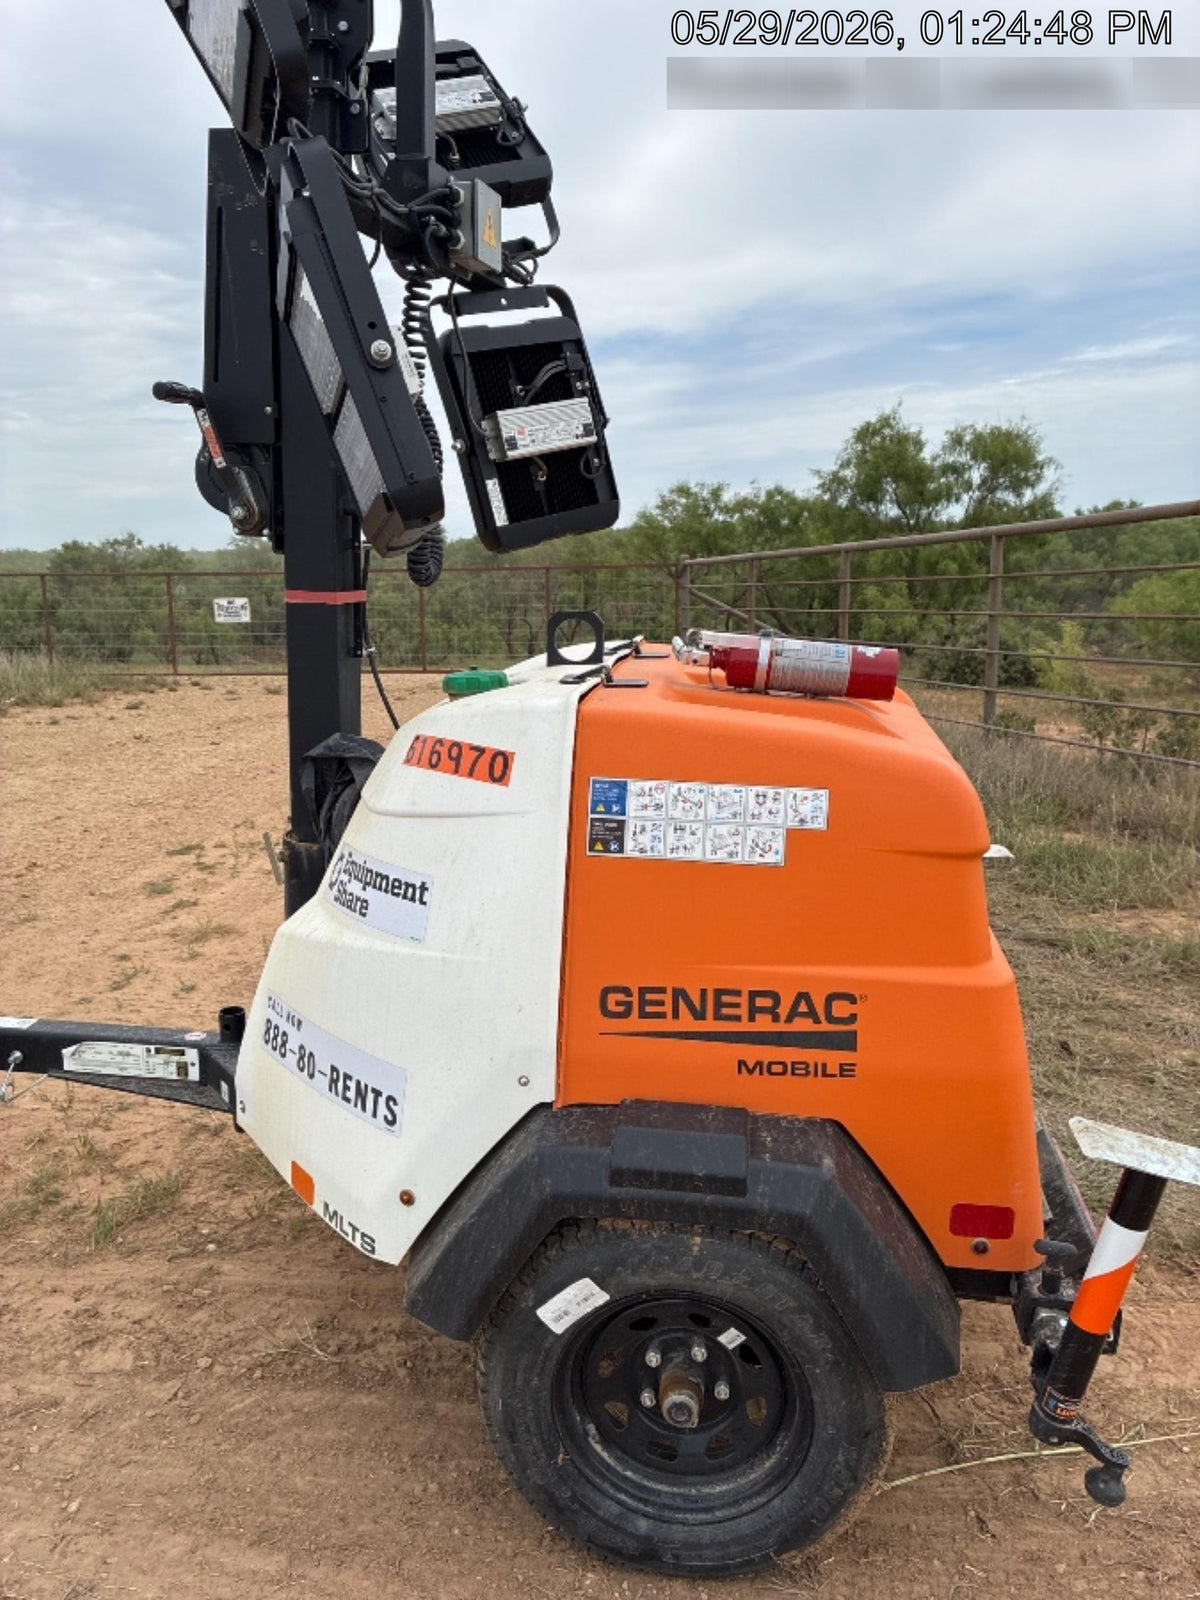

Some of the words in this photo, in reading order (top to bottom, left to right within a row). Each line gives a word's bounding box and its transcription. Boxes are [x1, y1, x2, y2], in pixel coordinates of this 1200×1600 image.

[342, 851, 429, 906] Equipment
[599, 985, 858, 1025] GENERAC
[263, 1018, 398, 1127] 888-80-RENTS
[737, 1059, 857, 1078] MOBILE
[323, 1200, 376, 1255] MLTS
